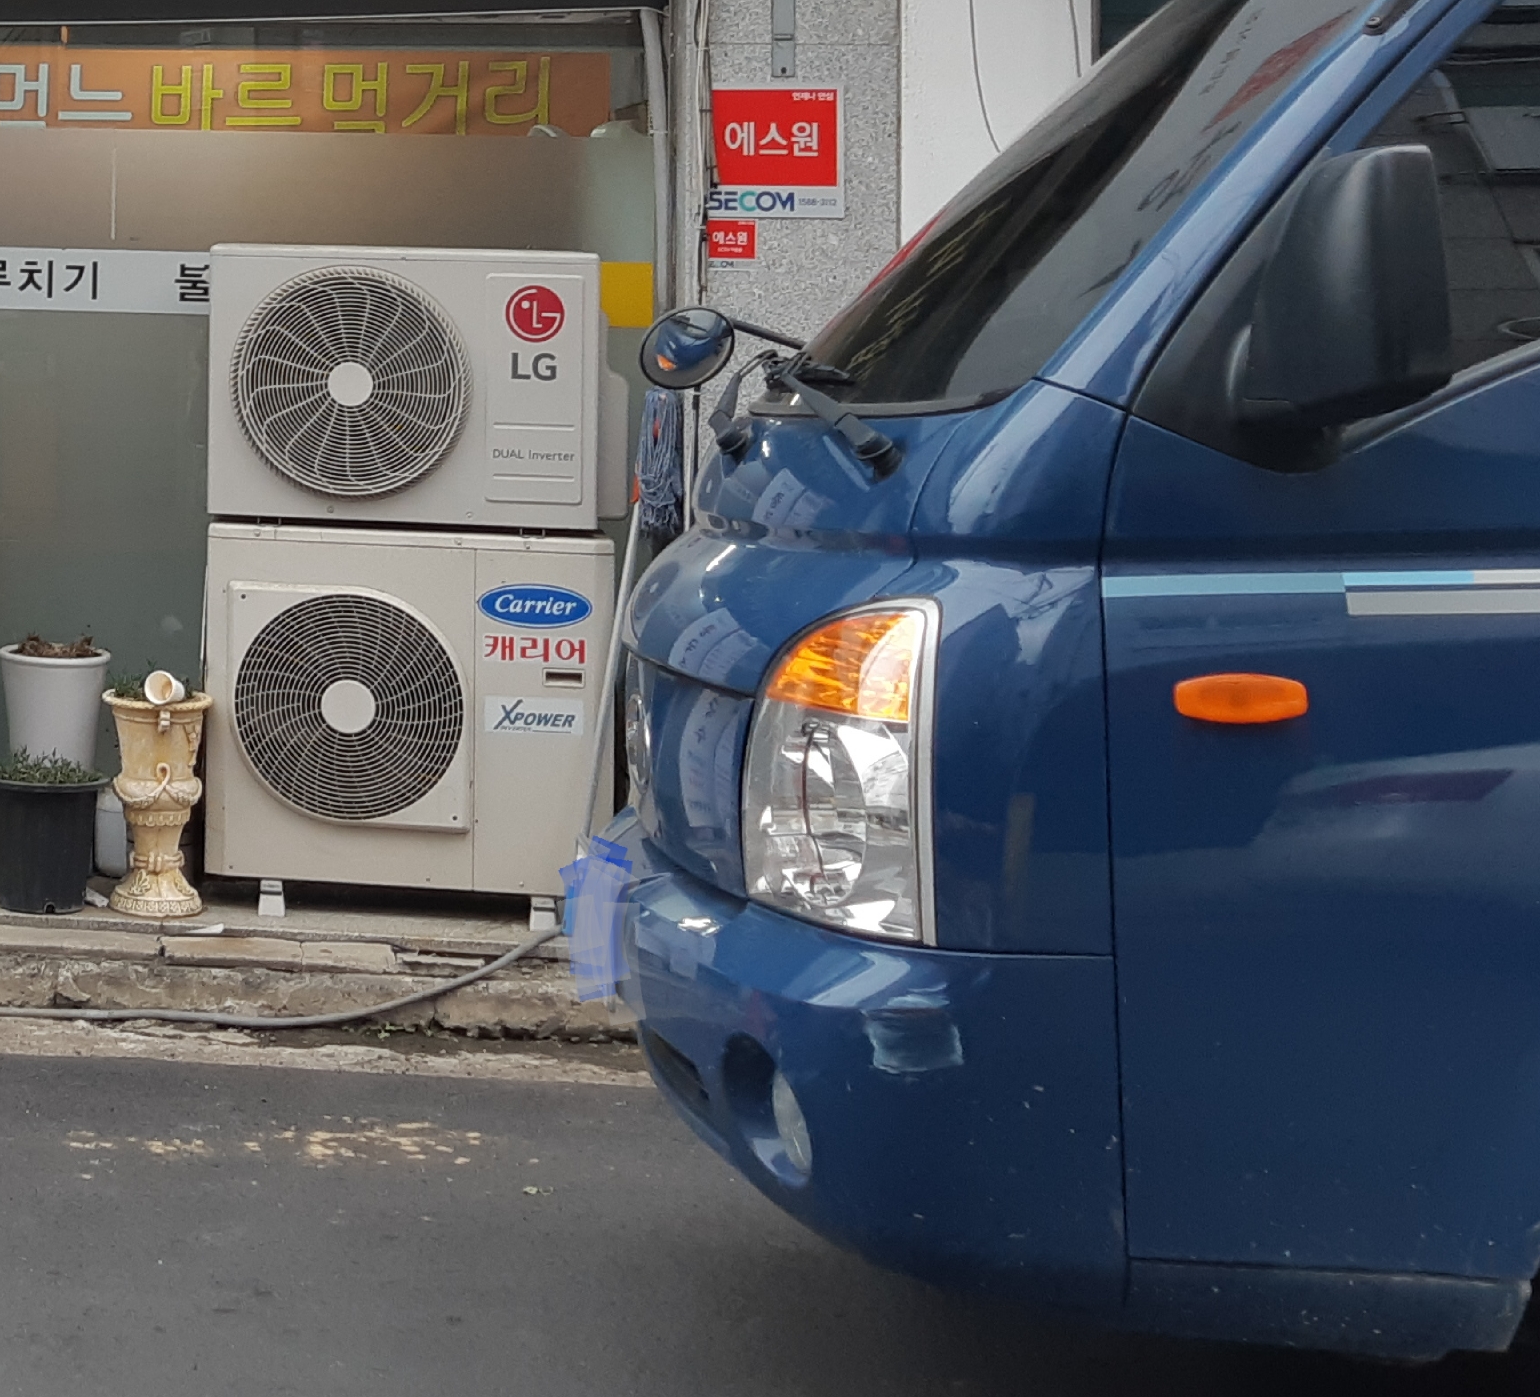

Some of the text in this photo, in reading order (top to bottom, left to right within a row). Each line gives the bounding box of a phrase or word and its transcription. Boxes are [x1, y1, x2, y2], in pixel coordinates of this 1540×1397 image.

[724, 121, 820, 157] 에스원
[708, 190, 795, 212] SECOM
[511, 353, 556, 381] LG
[493, 449, 575, 462] DUAL Inverter
[494, 594, 577, 616] Carrier
[485, 636, 585, 664] 캐리어
